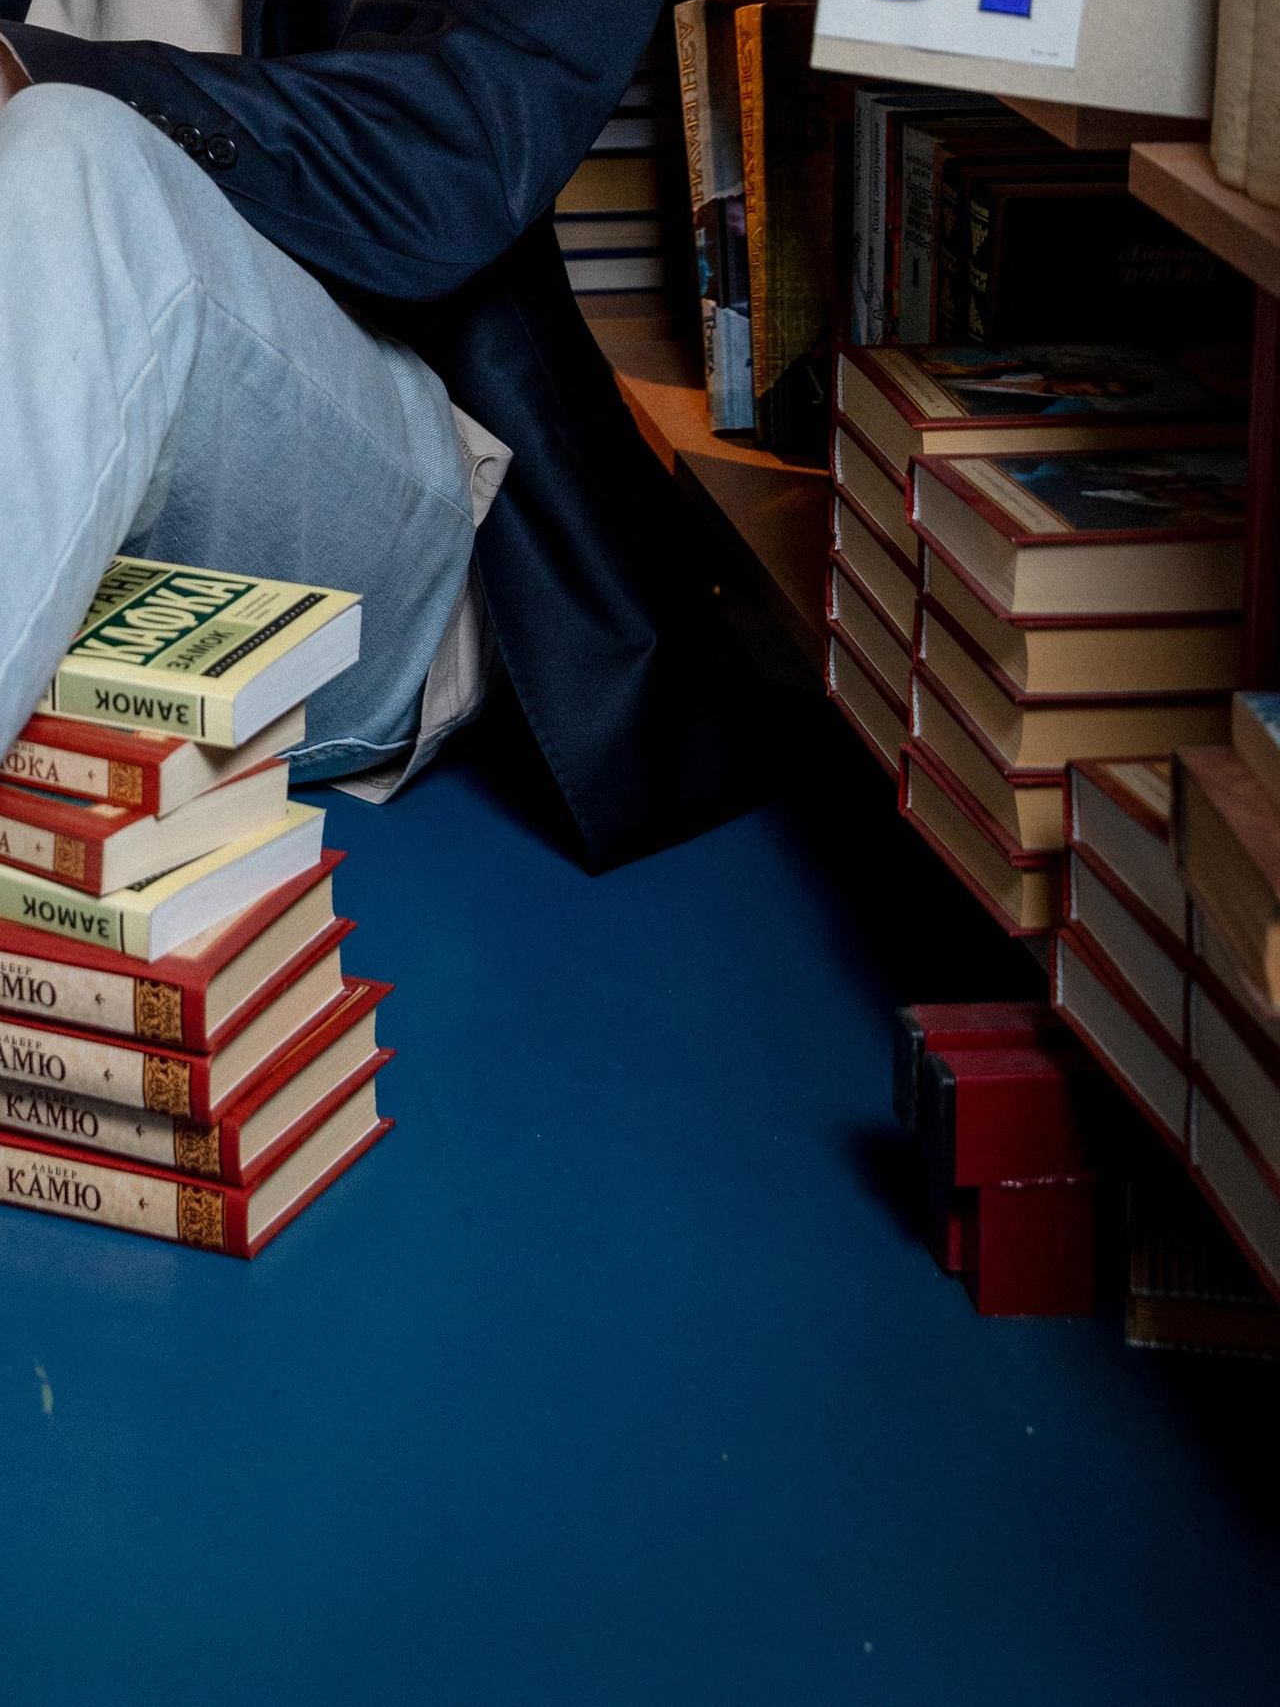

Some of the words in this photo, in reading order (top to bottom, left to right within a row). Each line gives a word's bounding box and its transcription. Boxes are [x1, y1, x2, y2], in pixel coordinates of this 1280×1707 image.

[72, 577, 257, 665] КАФКА
[167, 629, 234, 671] ЗАМОК
[94, 688, 190, 724] ЗАМОК
[23, 894, 111, 940] ЗАМОК
[6, 1094, 100, 1139] КАМЮ
[7, 1166, 102, 1212] КАМЮ
